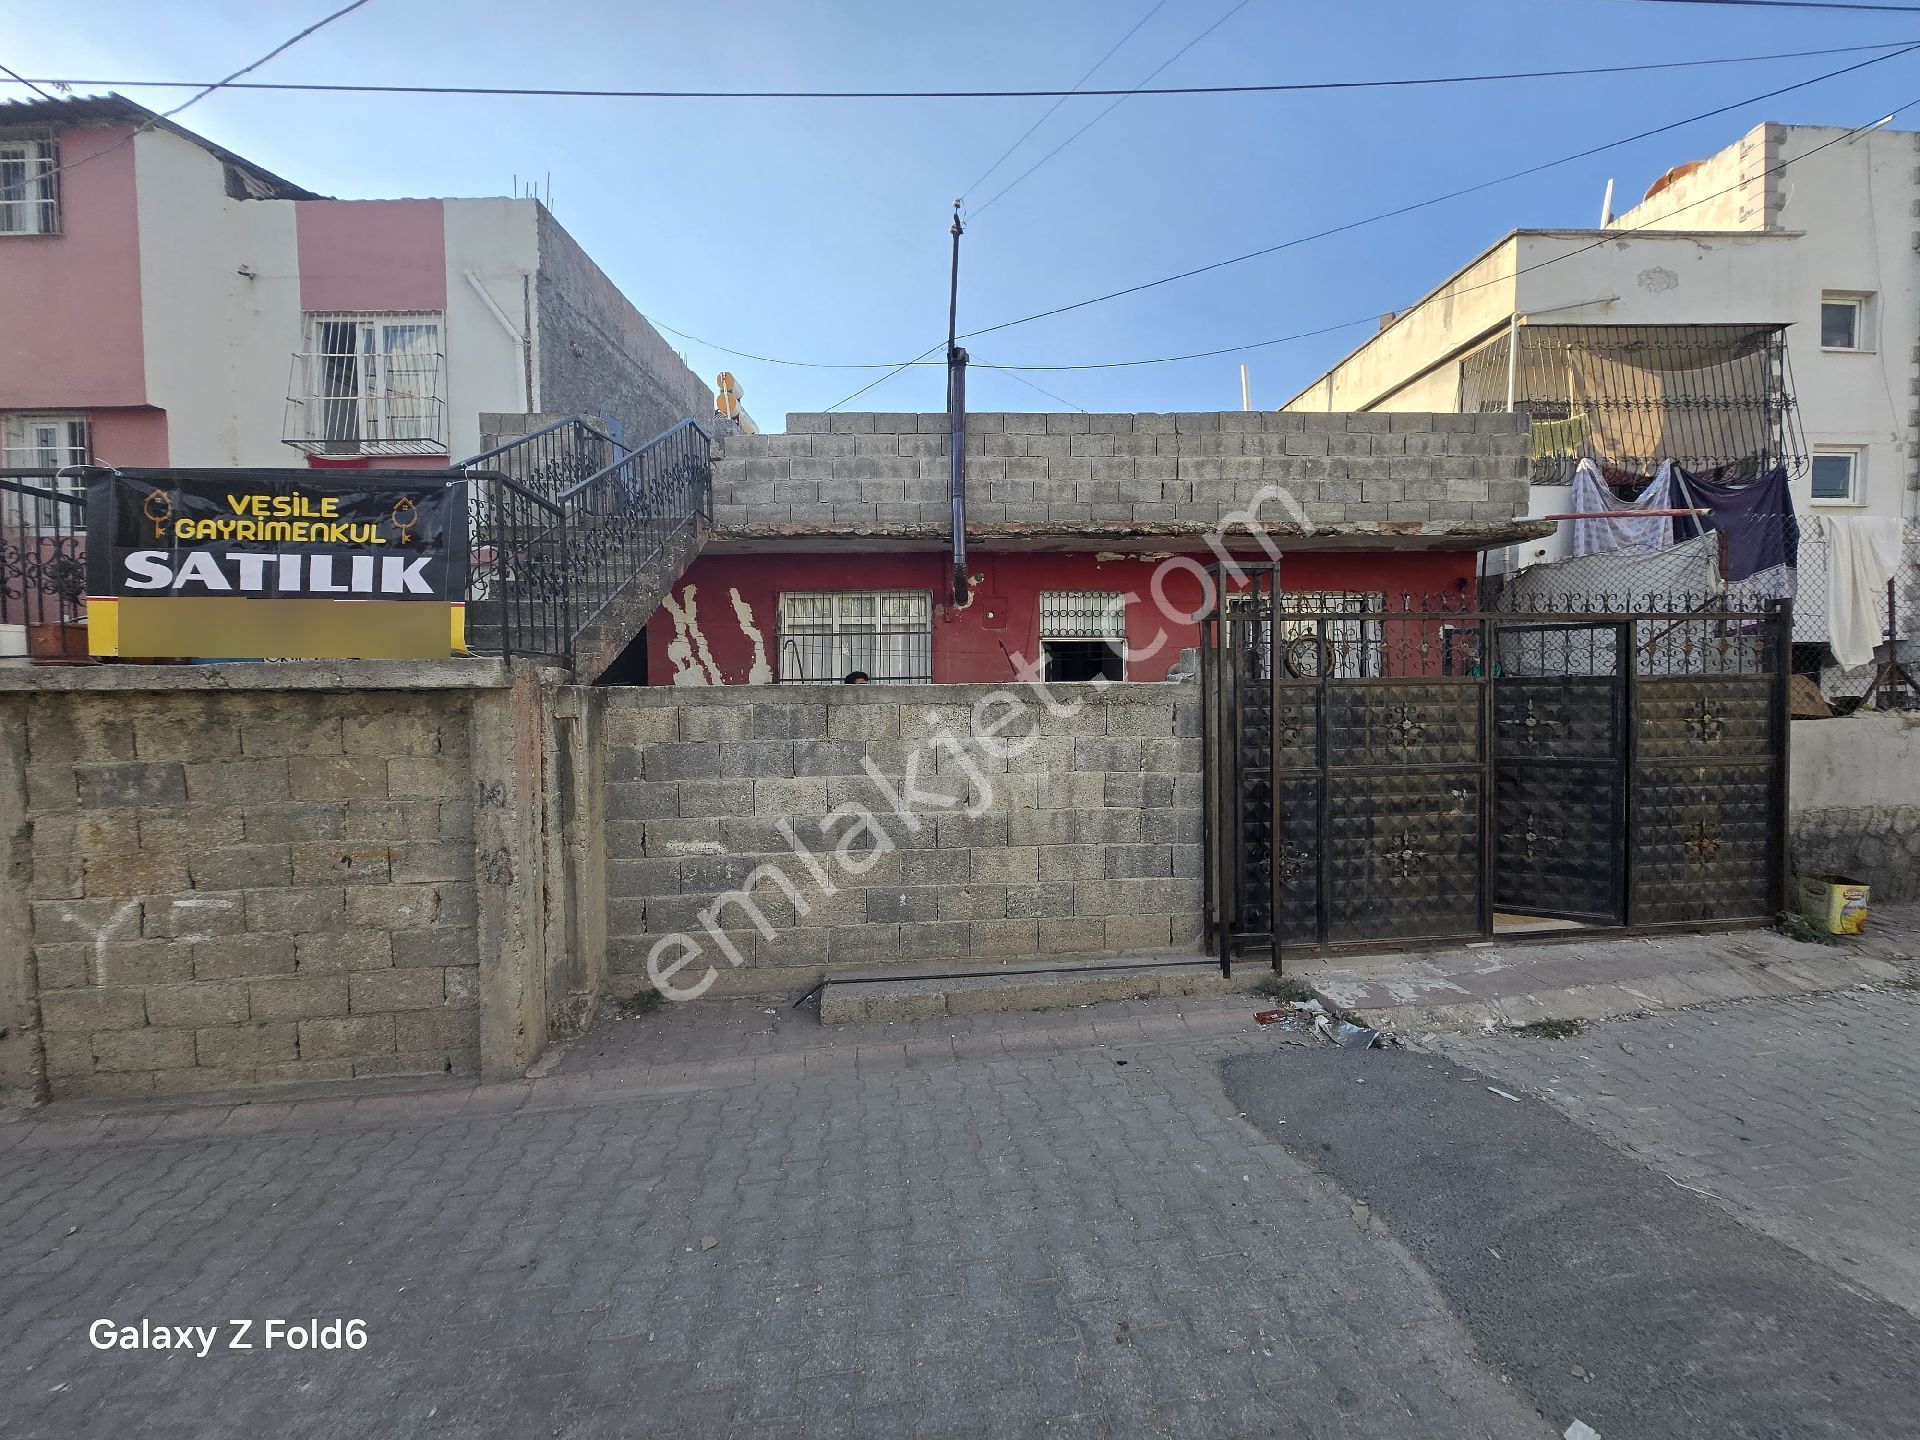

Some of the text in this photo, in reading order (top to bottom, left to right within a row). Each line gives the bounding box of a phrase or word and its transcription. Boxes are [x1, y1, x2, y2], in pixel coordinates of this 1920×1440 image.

[227, 491, 340, 518] VESİLE
[175, 516, 386, 544] GAYRİMENKUL
[124, 551, 435, 594] SATILIK
